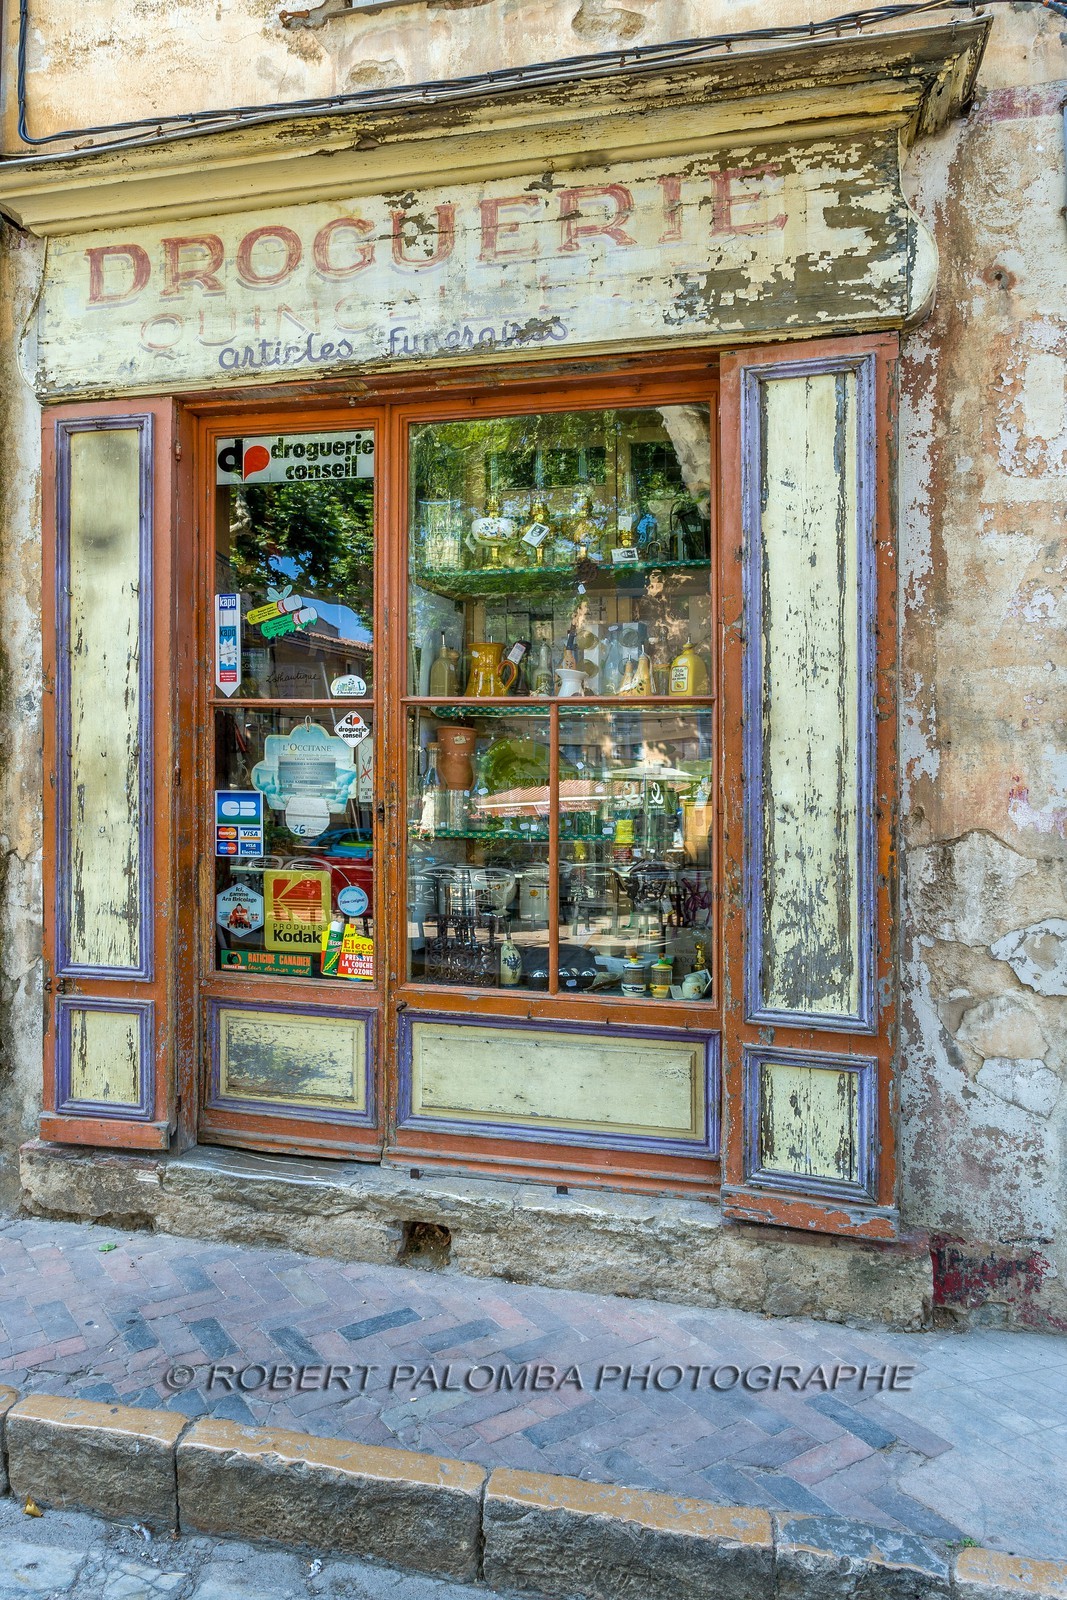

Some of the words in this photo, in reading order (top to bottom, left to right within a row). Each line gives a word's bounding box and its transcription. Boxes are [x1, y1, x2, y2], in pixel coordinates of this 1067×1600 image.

[84, 163, 788, 304] DROGUERIE
[218, 333, 354, 370] articles
[271, 433, 374, 461] droguerie
[285, 455, 358, 480] conseil
[219, 597, 236, 609] kapo
[219, 628, 236, 638] kapo
[338, 726, 367, 734] droguerie
[273, 923, 323, 931] PRODUITS
[273, 930, 322, 943] Kodak
[344, 939, 373, 950] Eleco
[248, 953, 275, 964] RATICIDE
[279, 955, 311, 966] CANADIEN
[351, 961, 373, 969] COUCHE
